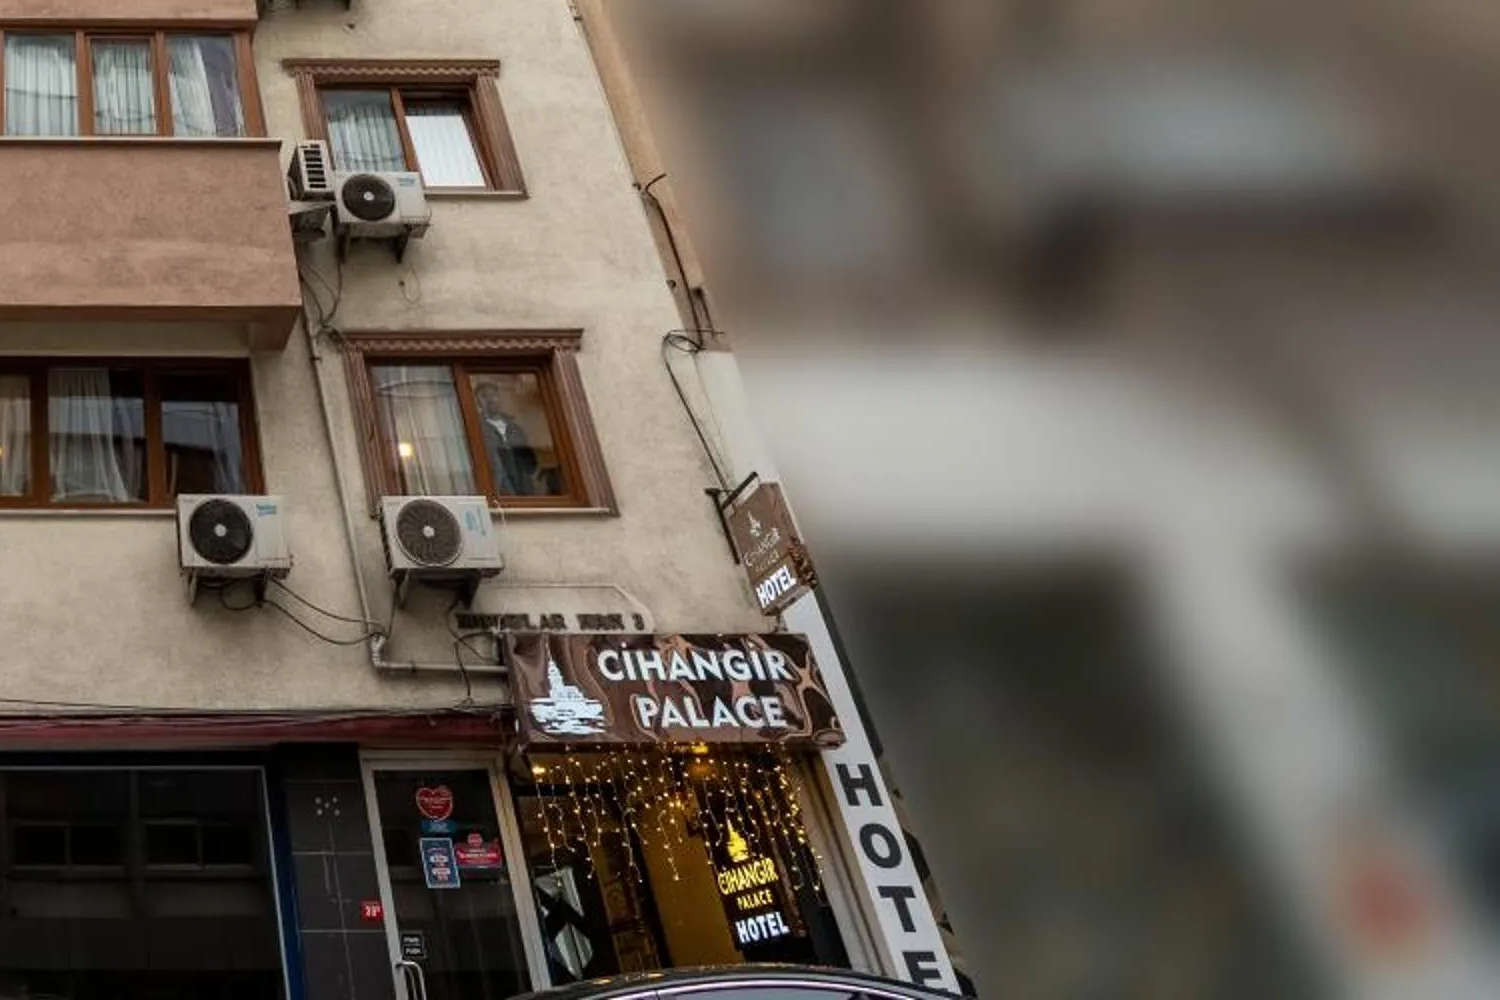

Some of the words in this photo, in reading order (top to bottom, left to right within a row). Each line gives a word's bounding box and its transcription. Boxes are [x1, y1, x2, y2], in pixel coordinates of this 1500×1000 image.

[756, 565, 796, 608] HOTEL
[598, 642, 794, 682] CİHANGİR
[638, 695, 788, 729] PALACE
[737, 889, 773, 910] PALACE
[735, 911, 790, 943] HOTEL
